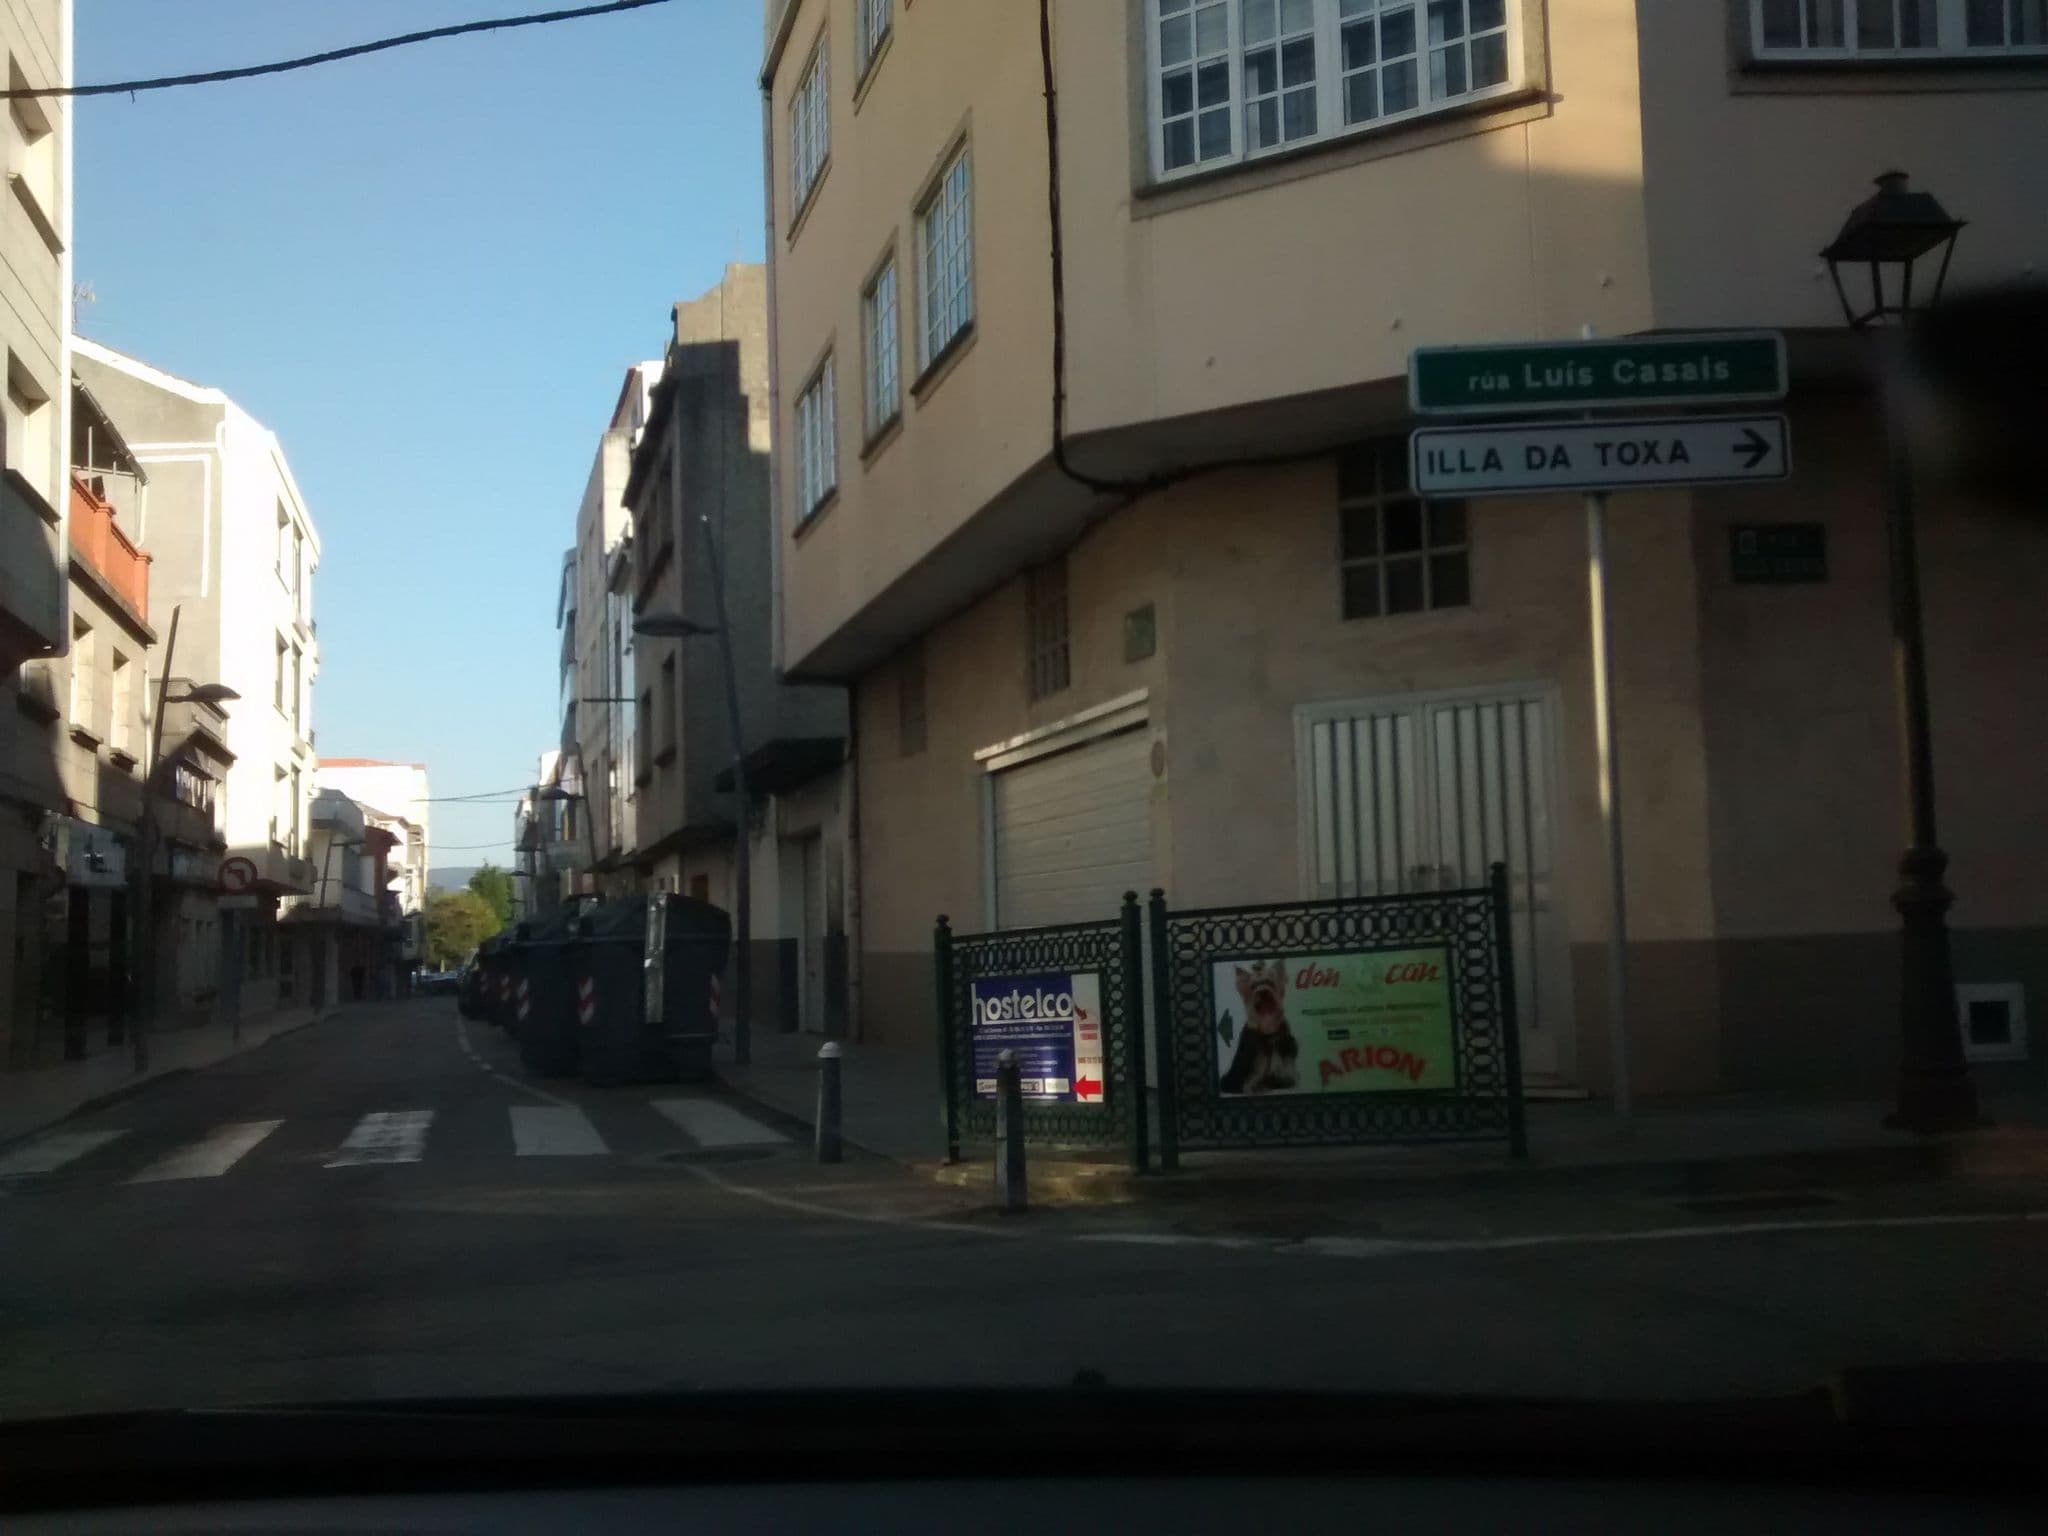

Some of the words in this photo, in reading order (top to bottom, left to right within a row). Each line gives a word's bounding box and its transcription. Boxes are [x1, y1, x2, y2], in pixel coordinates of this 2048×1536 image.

[1612, 358, 1730, 383] Casais
[1427, 445, 1503, 475] ILLA
[1525, 444, 1571, 471] DA
[1594, 439, 1691, 467] TOXA
[1296, 963, 1340, 989] don
[1385, 963, 1441, 985] can
[971, 983, 1073, 1025] hostelco
[1319, 1045, 1427, 1087] ARION
